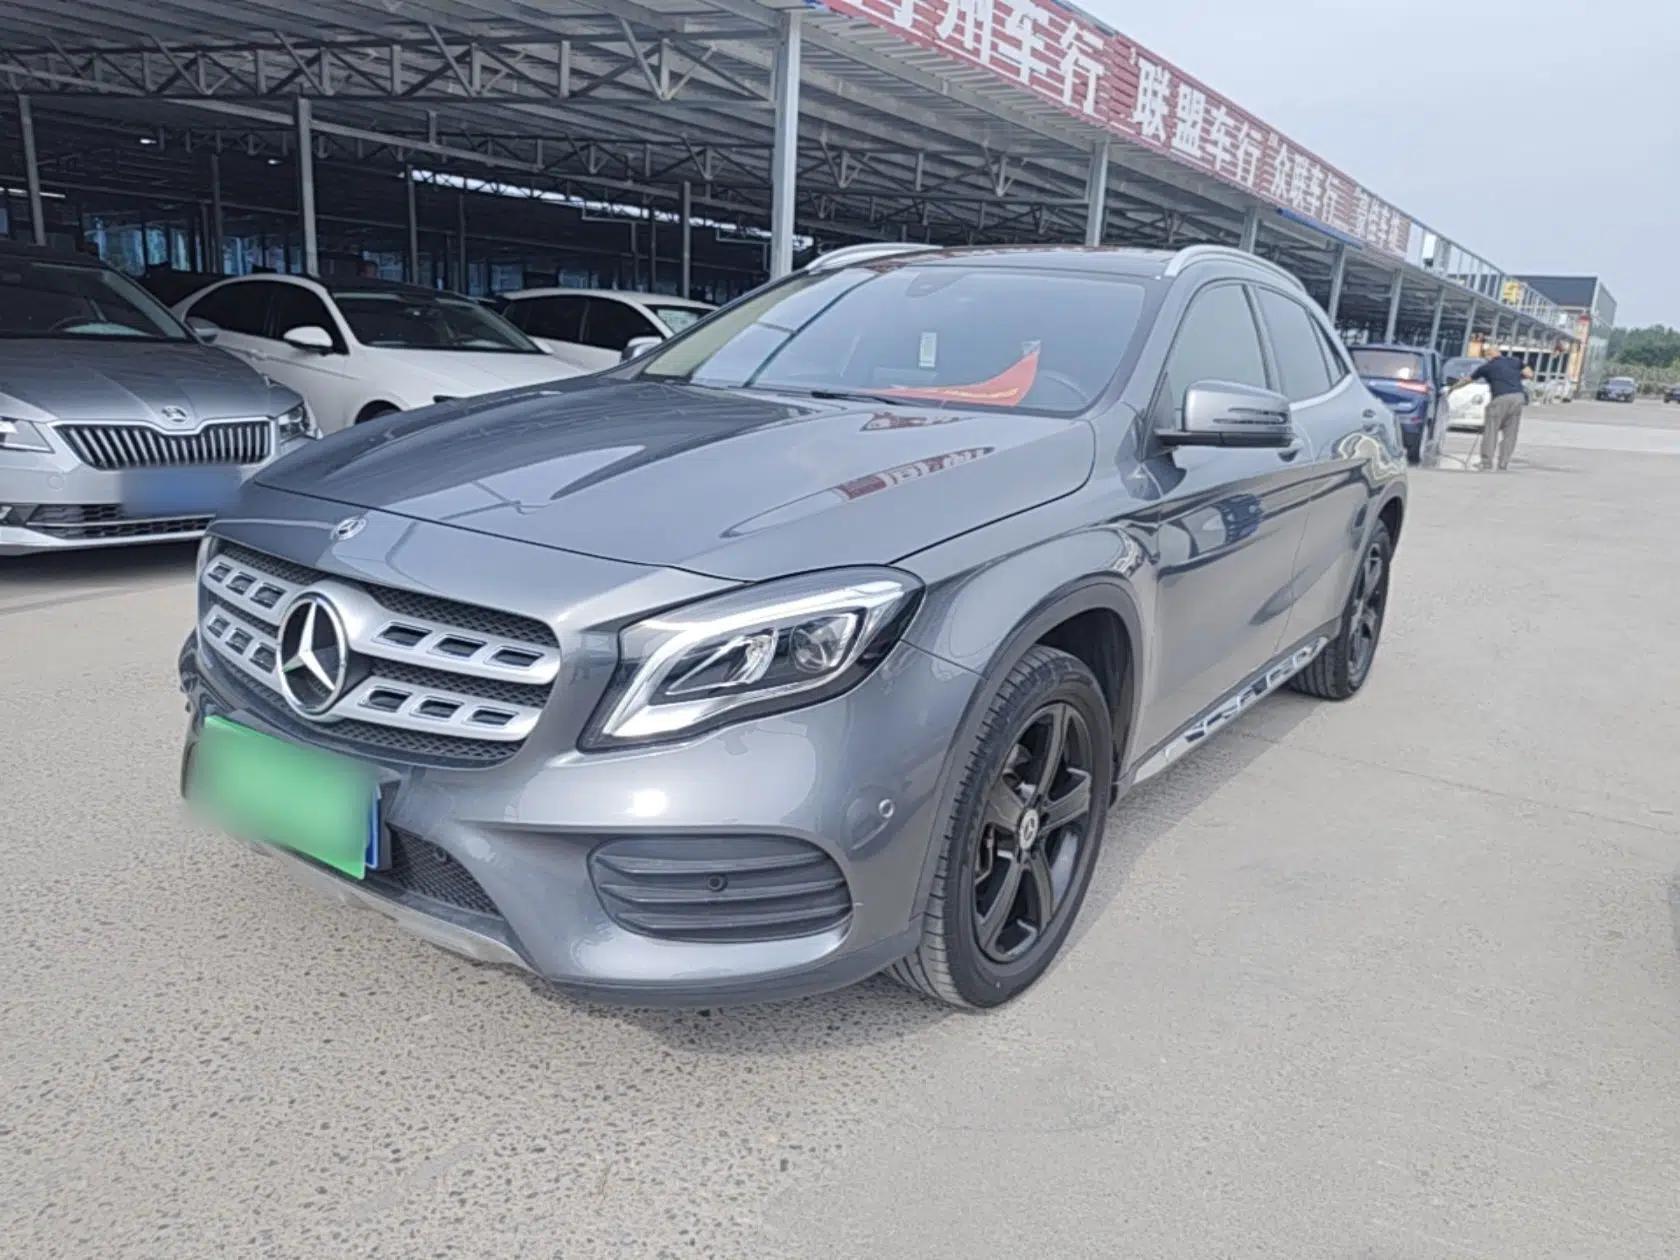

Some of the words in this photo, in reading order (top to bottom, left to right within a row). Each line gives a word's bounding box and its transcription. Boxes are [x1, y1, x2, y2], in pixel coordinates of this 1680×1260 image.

[890, 0, 1104, 115] 州车行
[1131, 56, 1263, 187] 联盟车行
